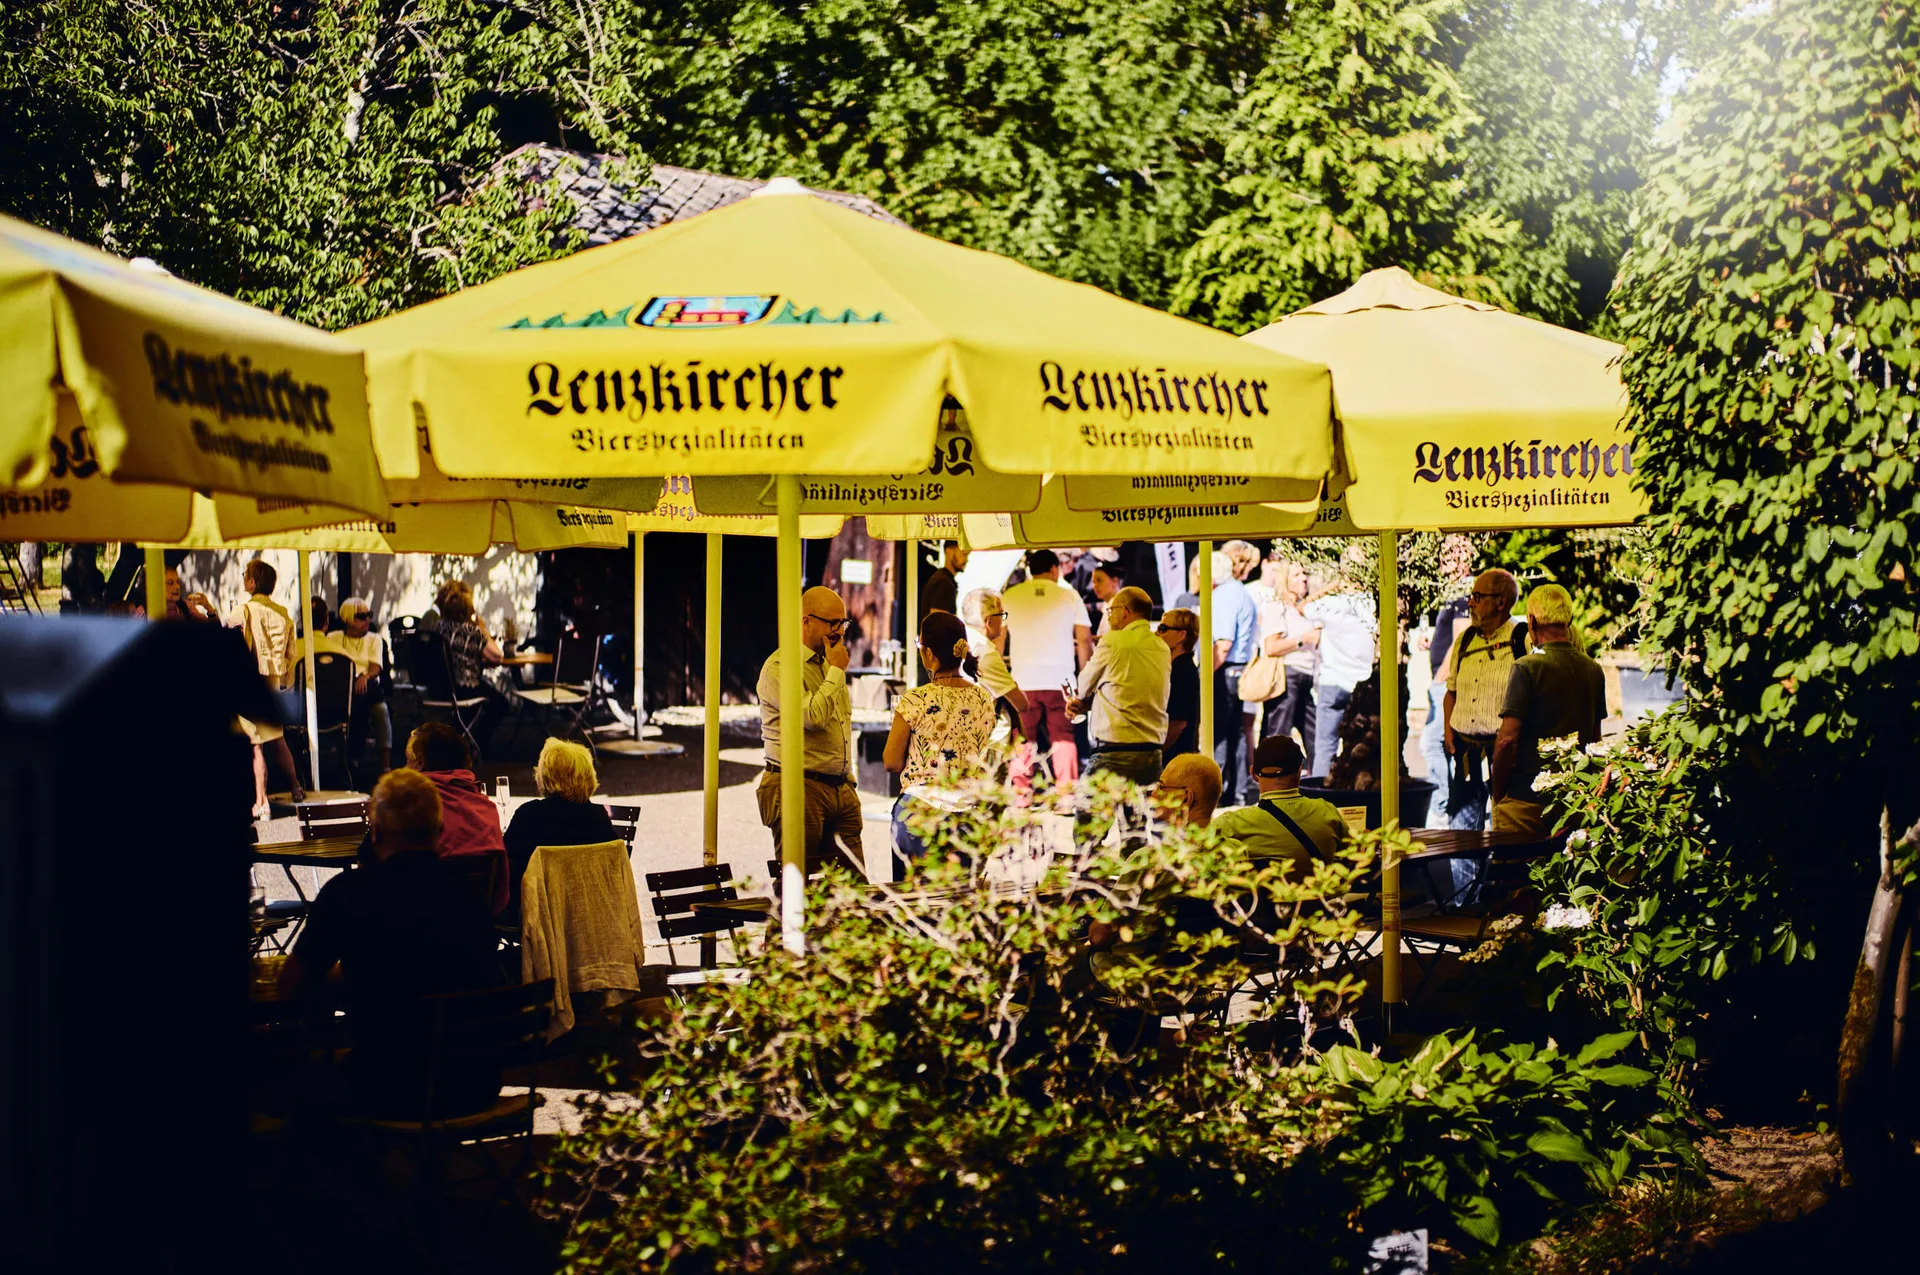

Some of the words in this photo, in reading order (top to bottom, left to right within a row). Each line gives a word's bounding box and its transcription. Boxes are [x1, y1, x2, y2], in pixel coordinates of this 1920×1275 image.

[525, 360, 845, 422] Lenzkircher
[1039, 360, 1270, 422] Lenzkircher
[571, 428, 805, 456] Bierspezialitäten
[1080, 424, 1254, 454] Bierspezialitäten
[1445, 487, 1610, 513] Bierspezialitäten
